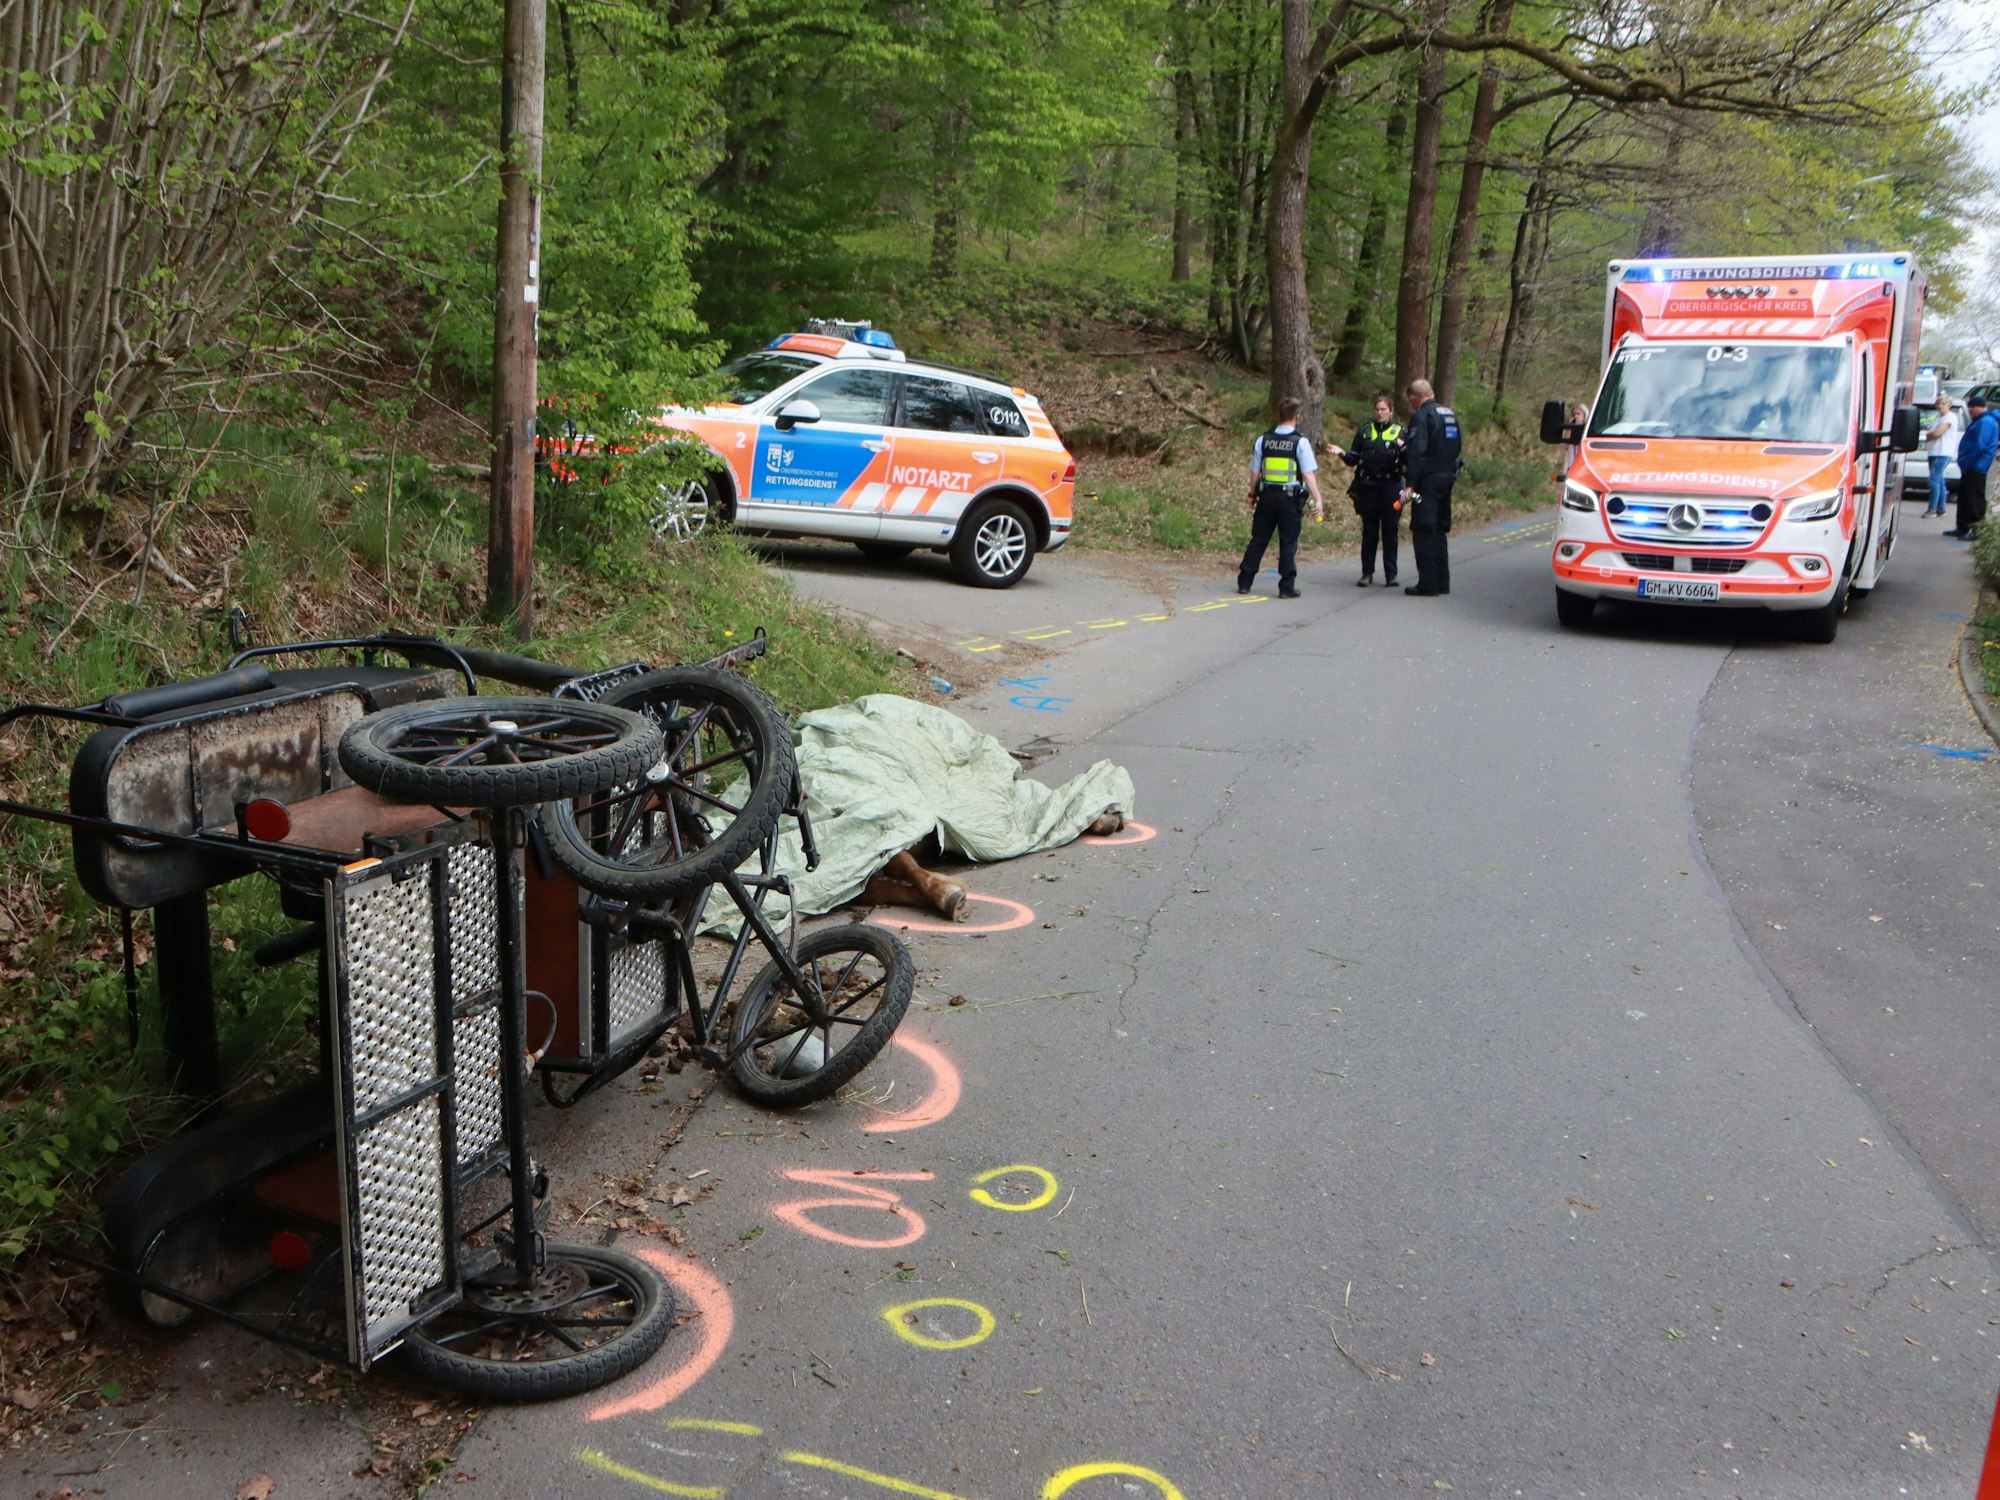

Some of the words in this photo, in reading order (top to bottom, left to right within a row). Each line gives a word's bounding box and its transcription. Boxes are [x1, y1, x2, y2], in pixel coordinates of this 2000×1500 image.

[1671, 266, 1828, 279] RETTUNGSDIENST
[1669, 299, 1772, 312] OBERBERGISCHER
[1774, 300, 1808, 311] KREIS
[1003, 411, 1020, 426] 112
[735, 431, 746, 449] 2
[1264, 440, 1294, 451] POLIZEI
[780, 467, 825, 477] OBERBERGISCHER
[824, 470, 839, 478] KREIS
[892, 465, 972, 491] NOTARZT
[765, 475, 838, 489] RETTUNGSDIENST
[1609, 471, 1781, 489] RETTUNGSDIENST
[1685, 584, 1714, 598] 6604
